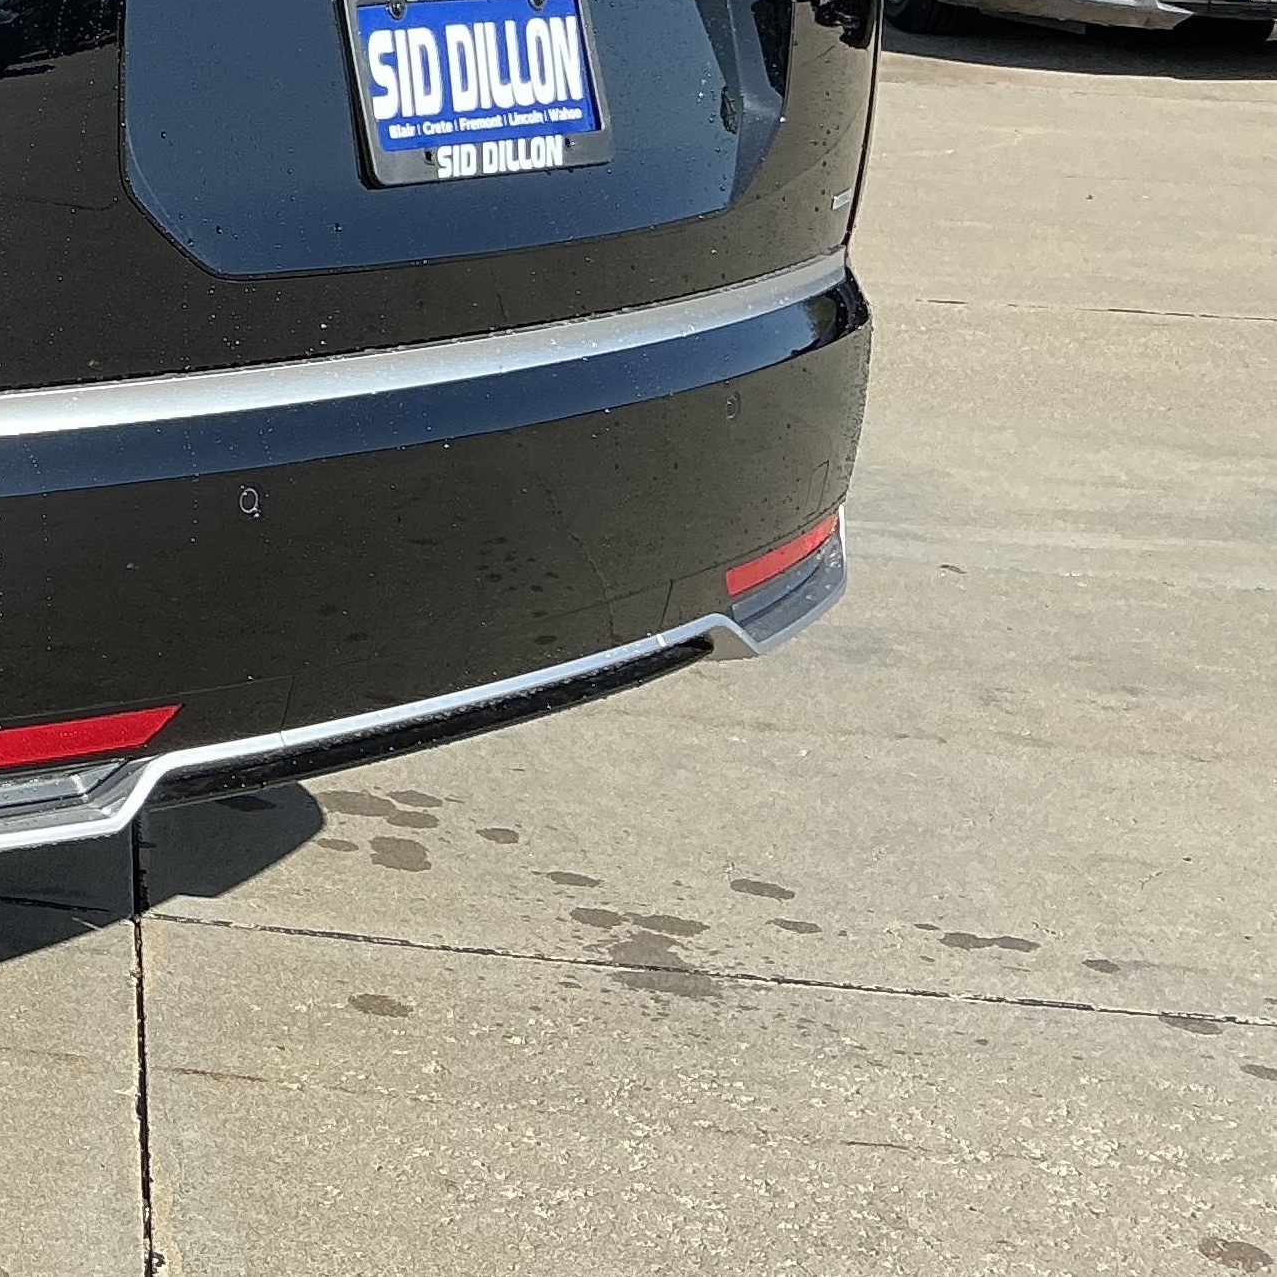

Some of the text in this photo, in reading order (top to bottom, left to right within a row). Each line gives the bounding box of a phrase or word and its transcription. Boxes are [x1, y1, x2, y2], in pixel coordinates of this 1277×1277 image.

[367, 15, 584, 121] SID DILLON
[436, 134, 564, 179] SID DILLON
